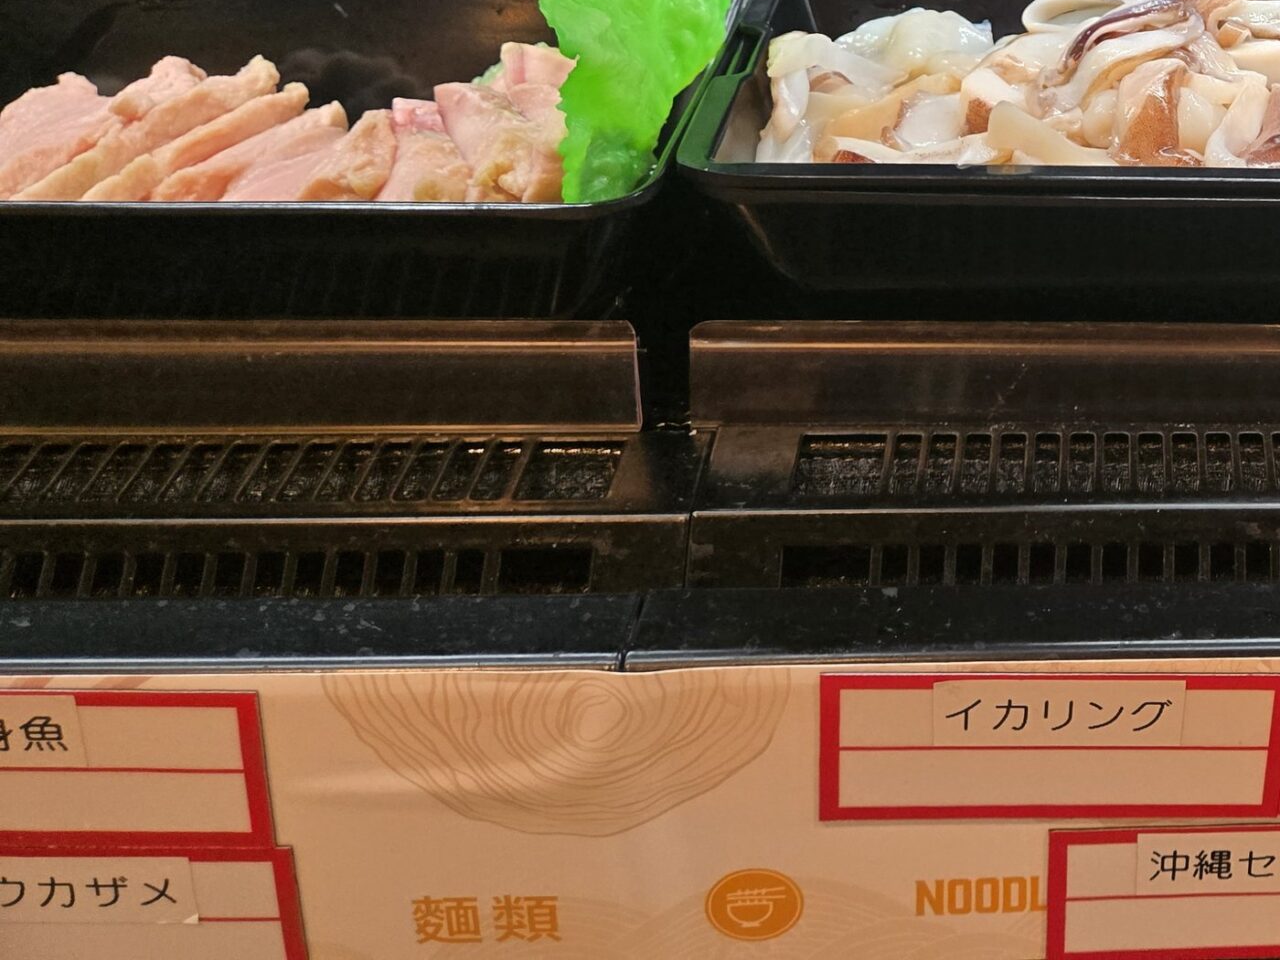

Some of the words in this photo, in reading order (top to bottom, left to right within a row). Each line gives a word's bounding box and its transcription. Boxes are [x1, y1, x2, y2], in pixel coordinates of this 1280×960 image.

[945, 699, 1172, 731] イカリング
[915, 875, 1048, 916] NOODL
